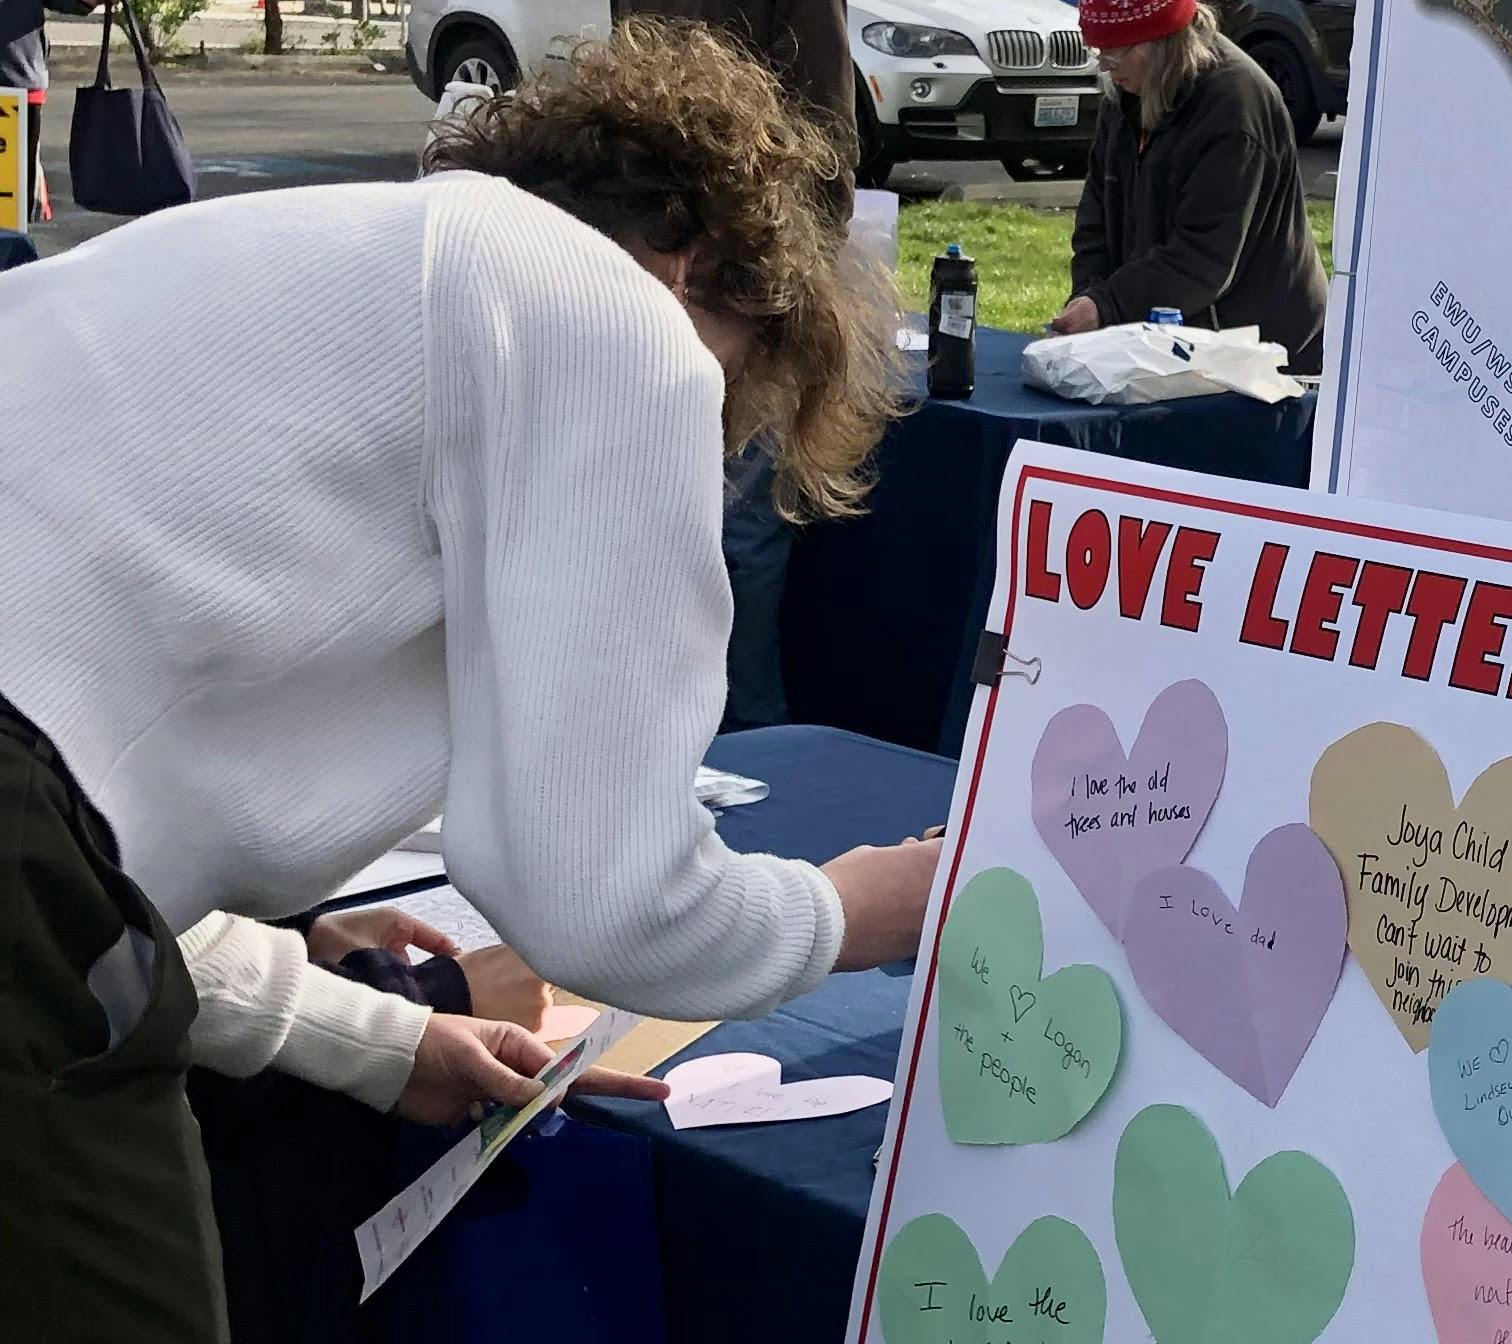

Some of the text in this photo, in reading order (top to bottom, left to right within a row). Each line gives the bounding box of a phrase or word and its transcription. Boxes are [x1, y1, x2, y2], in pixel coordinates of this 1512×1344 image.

[1025, 499, 1222, 633] LOVE
[1085, 773, 1110, 799] love
[1114, 773, 1138, 799] the
[1147, 761, 1171, 793] old
[1064, 801, 1192, 840] trees and houses
[1386, 803, 1443, 869] Joya
[1452, 819, 1510, 873] Child
[1357, 852, 1430, 922] Family
[1159, 895, 1175, 910] I
[1249, 927, 1278, 952] dad
[1423, 930, 1467, 966] wait
[1473, 942, 1493, 974] to
[970, 946, 1091, 1080] We Logan
[953, 1023, 1038, 1105] the people
[914, 1281, 1070, 1325] I love the
